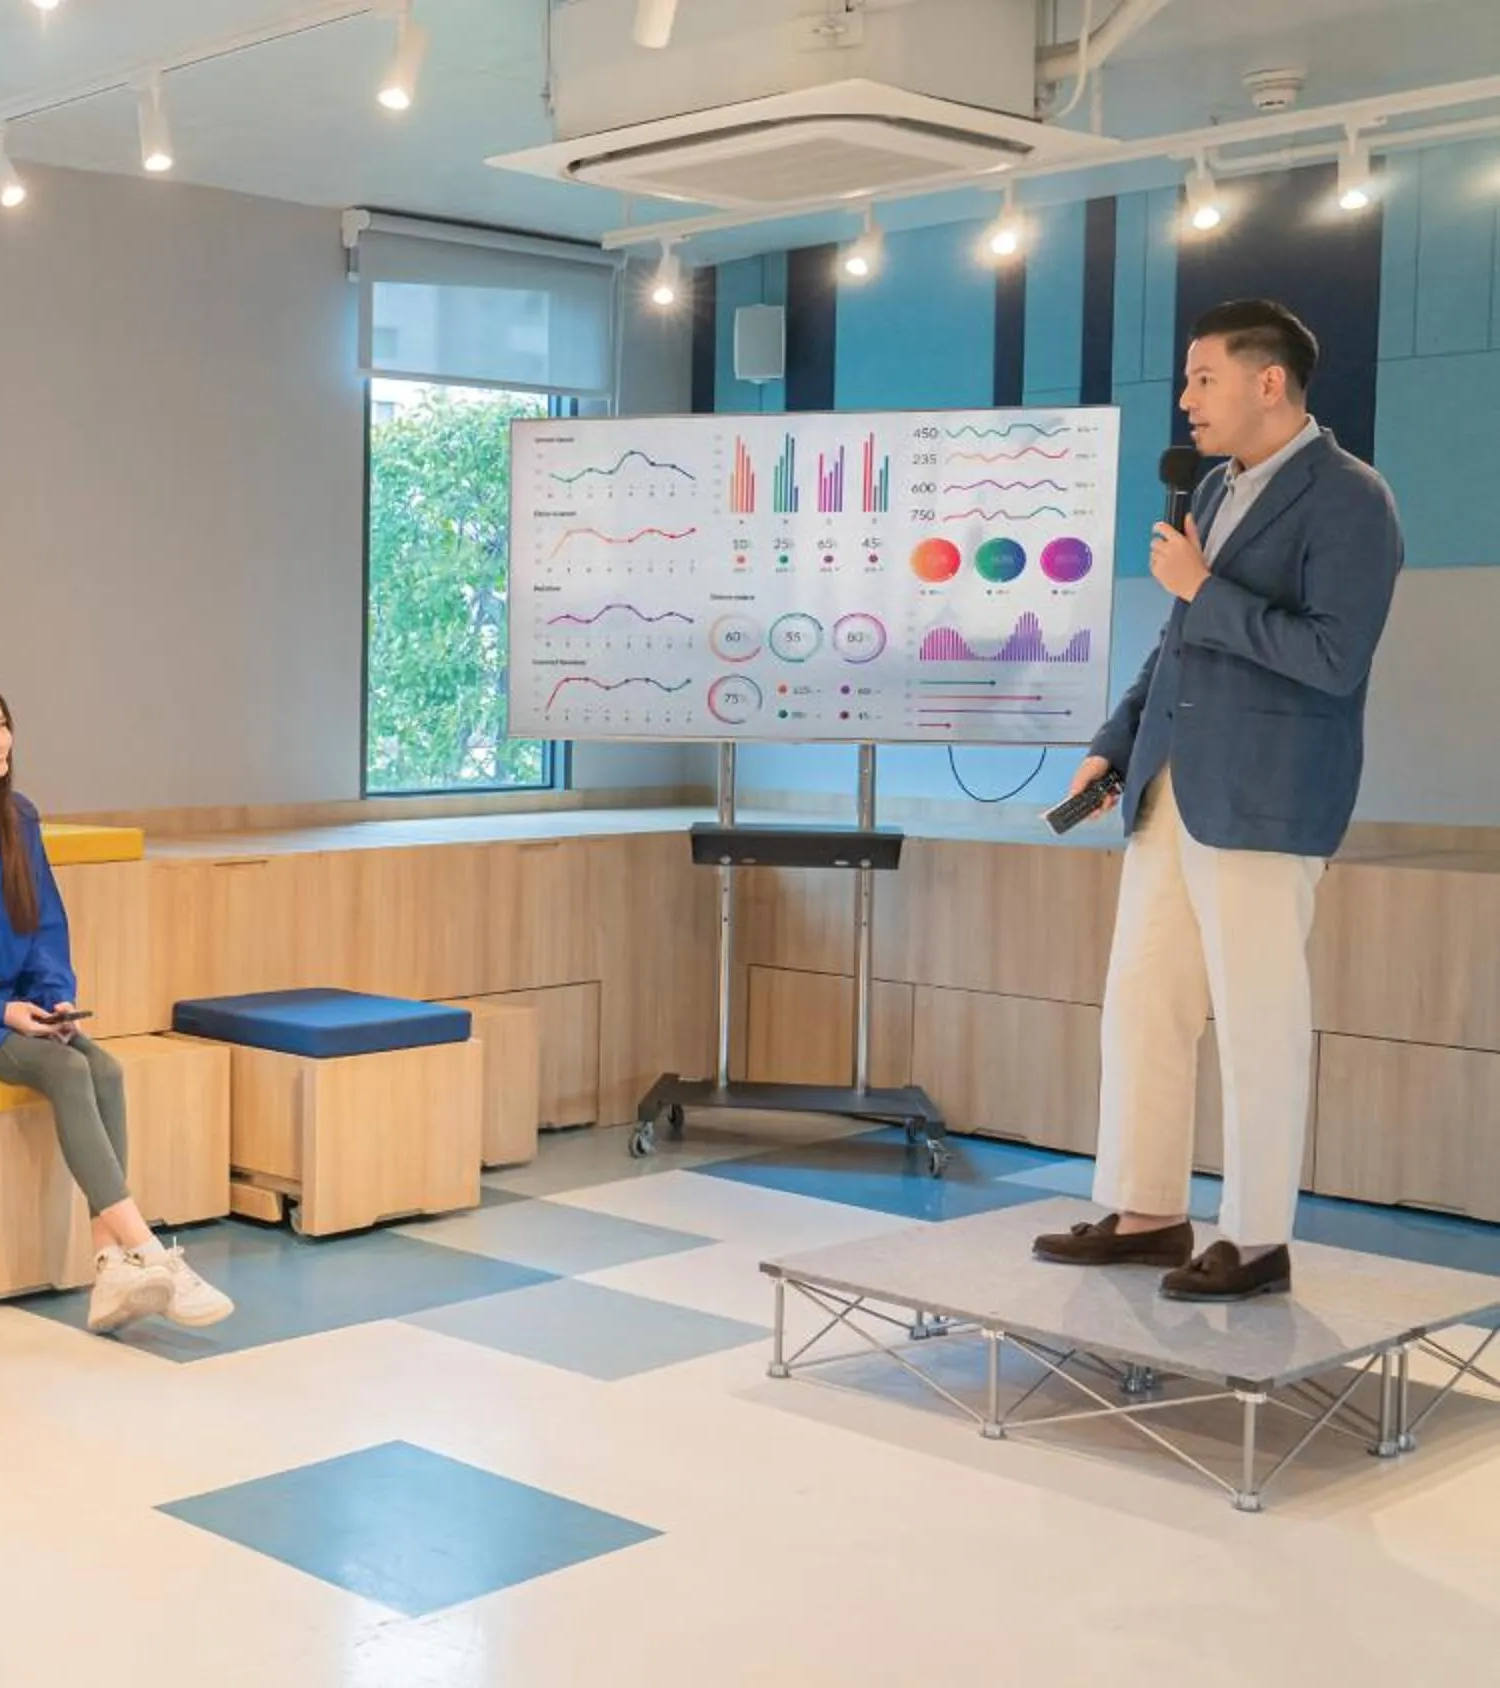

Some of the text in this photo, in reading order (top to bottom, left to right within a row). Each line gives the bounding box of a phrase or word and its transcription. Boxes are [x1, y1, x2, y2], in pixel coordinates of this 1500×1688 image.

[912, 427, 939, 438] 450
[912, 453, 937, 465] 235
[910, 482, 937, 494] 600
[910, 509, 935, 521] 750
